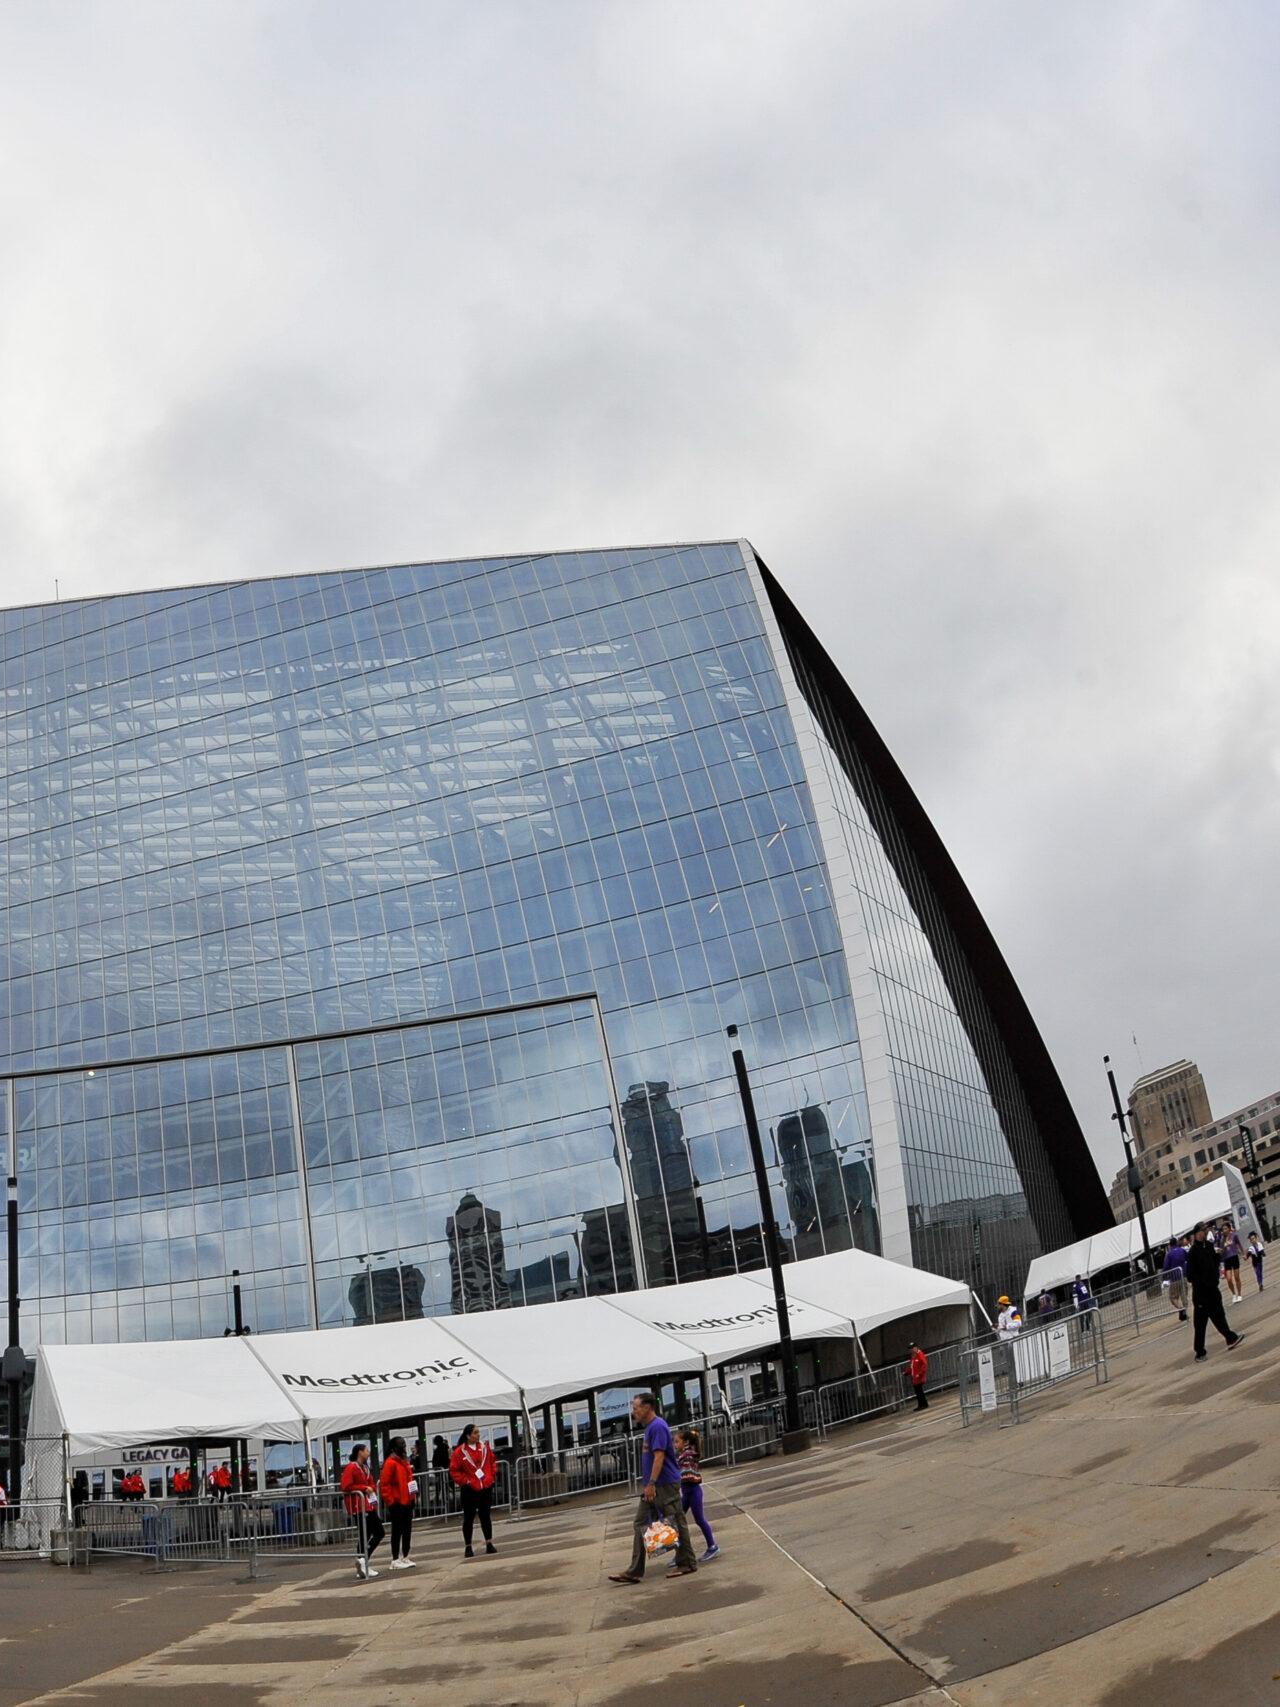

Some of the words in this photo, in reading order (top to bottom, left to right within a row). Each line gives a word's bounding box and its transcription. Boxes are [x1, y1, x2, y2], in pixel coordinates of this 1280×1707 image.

[758, 1308, 805, 1325] PLZA
[281, 1356, 470, 1387] Medtronic
[415, 1368, 477, 1386] PLAZA
[122, 1448, 168, 1462] LEGACY
[171, 1448, 204, 1459] GAE
